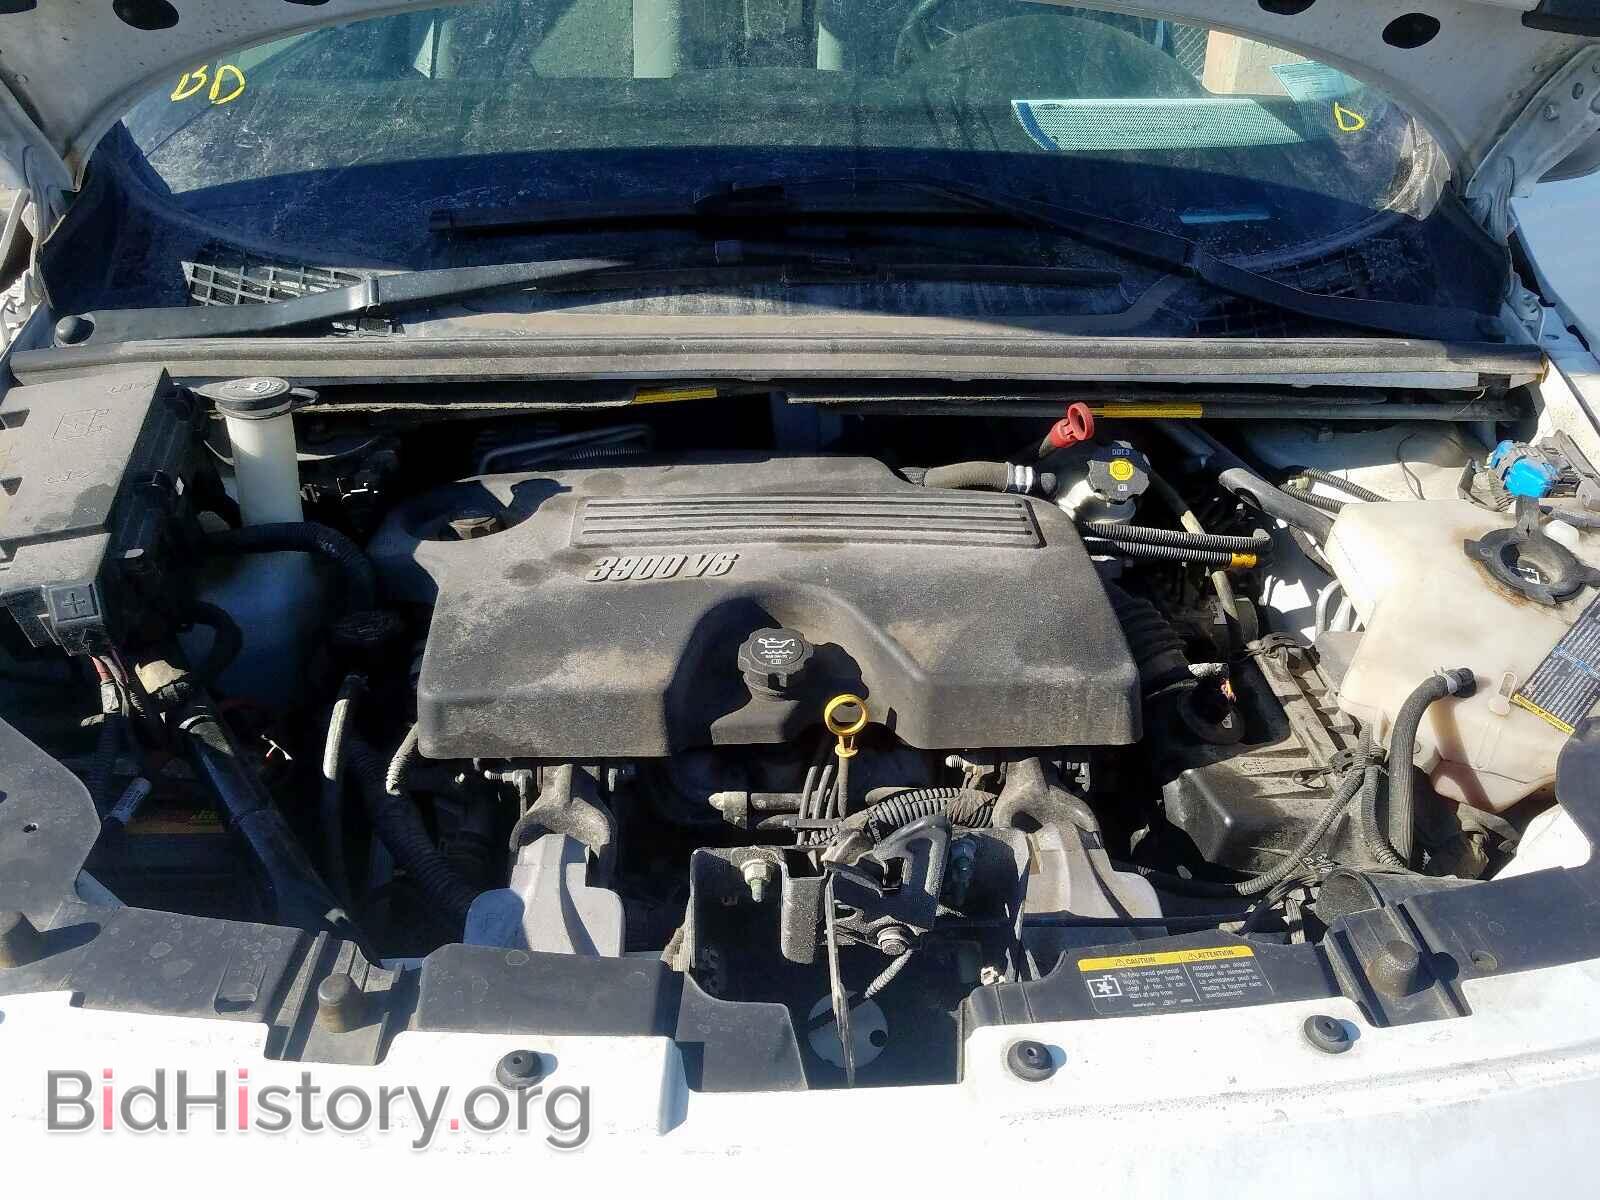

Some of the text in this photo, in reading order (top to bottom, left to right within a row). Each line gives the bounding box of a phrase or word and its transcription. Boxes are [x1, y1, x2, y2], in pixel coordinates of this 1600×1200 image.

[585, 551, 741, 582] 3900 V6
[1125, 949, 1234, 965] CAUTION ATTENTION
